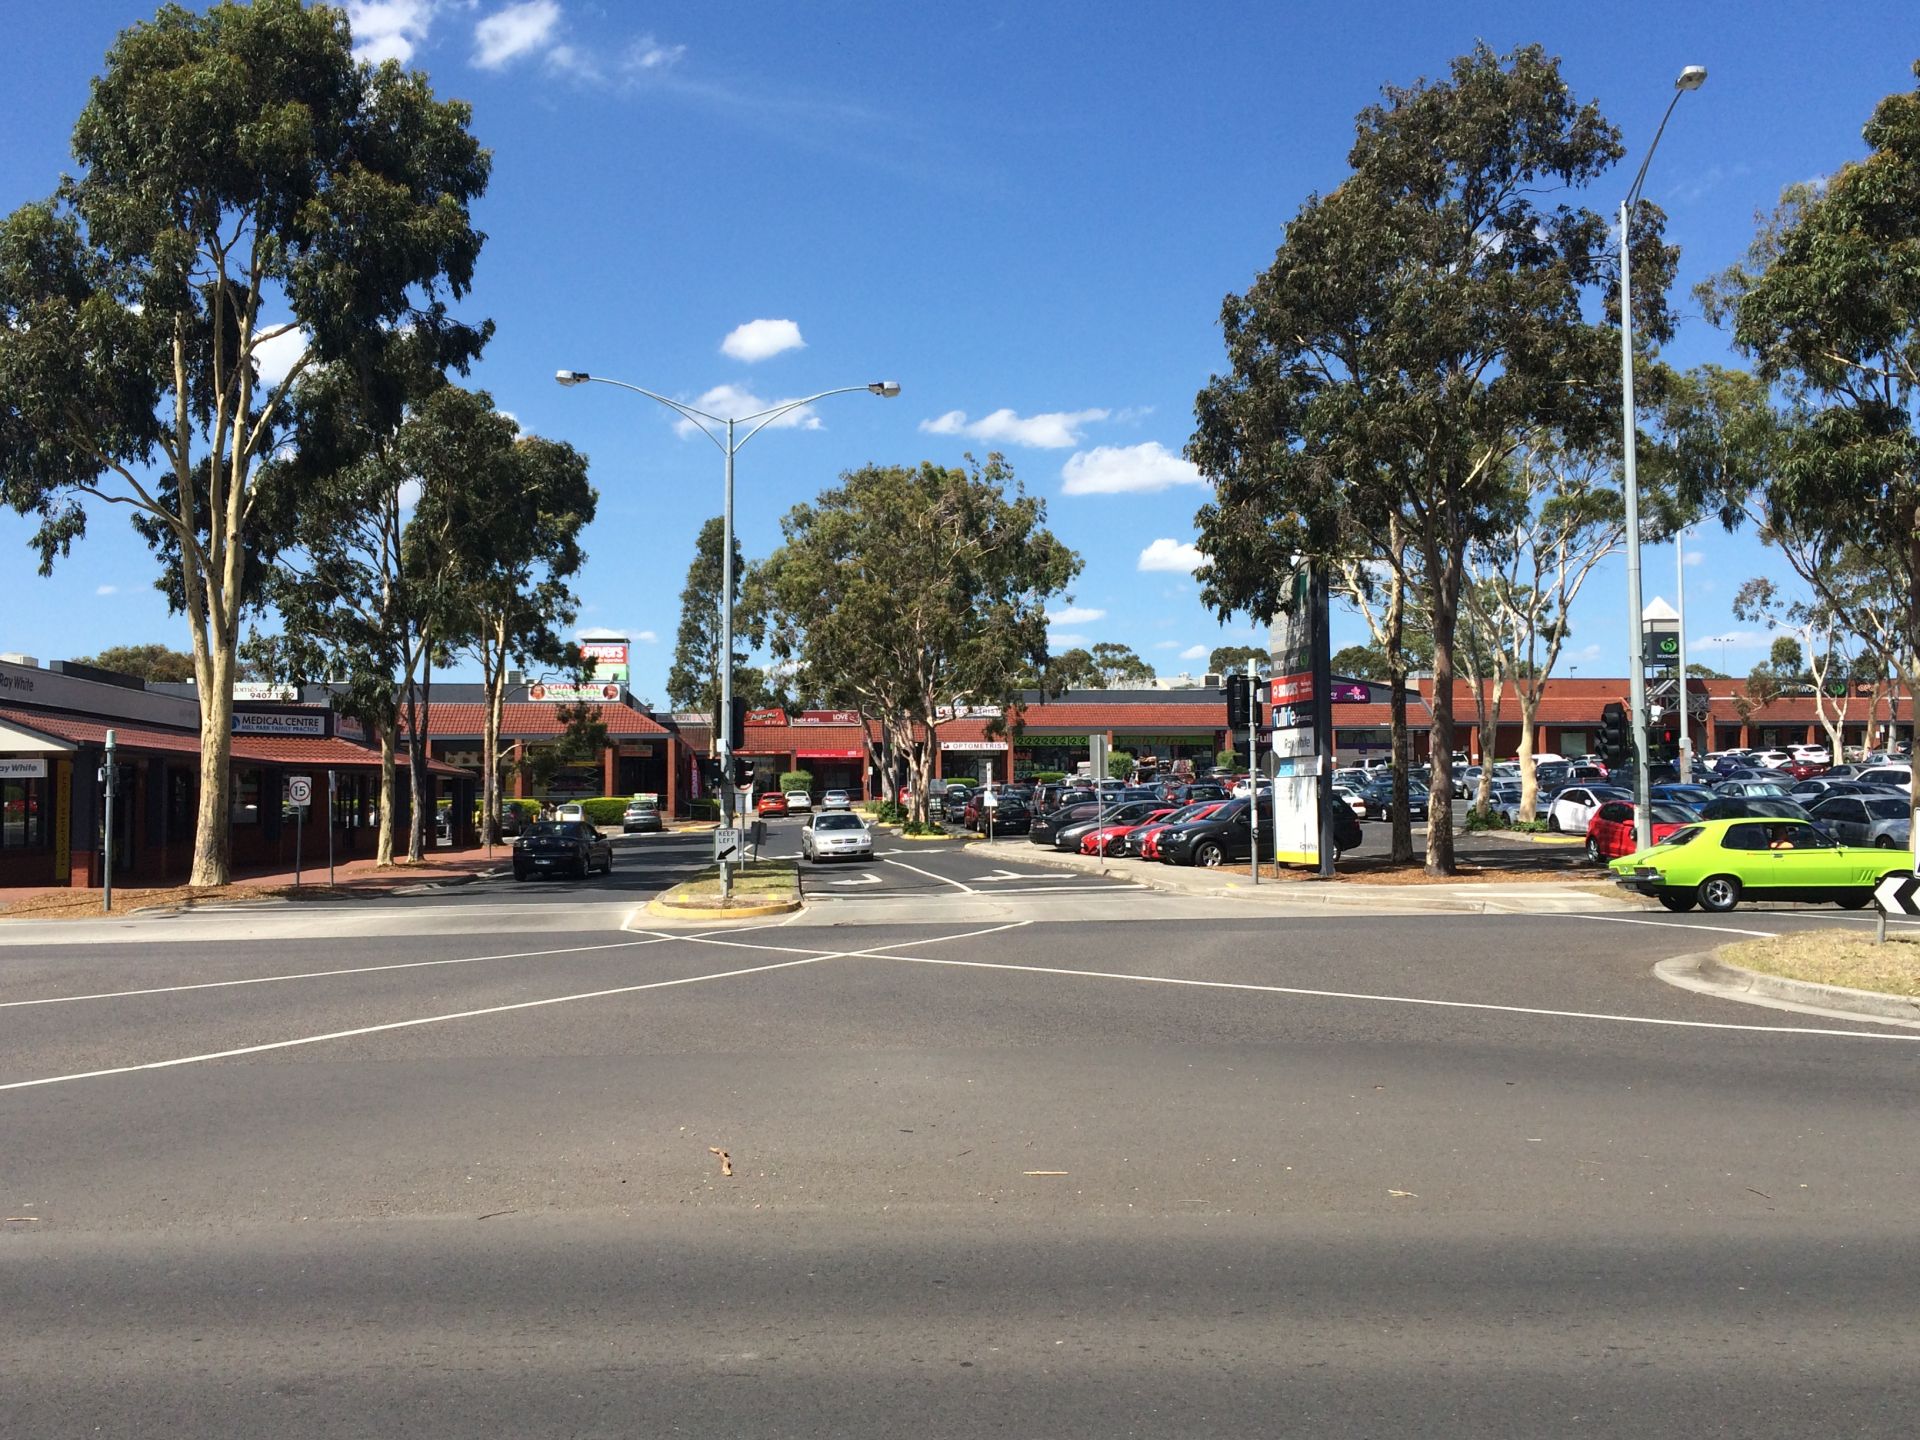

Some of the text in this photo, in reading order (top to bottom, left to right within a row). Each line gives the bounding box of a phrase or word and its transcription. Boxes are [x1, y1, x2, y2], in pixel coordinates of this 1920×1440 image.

[14, 677, 34, 692] White
[242, 715, 319, 727] MEDICAL CENTRE
[12, 764, 37, 772] White
[294, 785, 306, 797] 15
